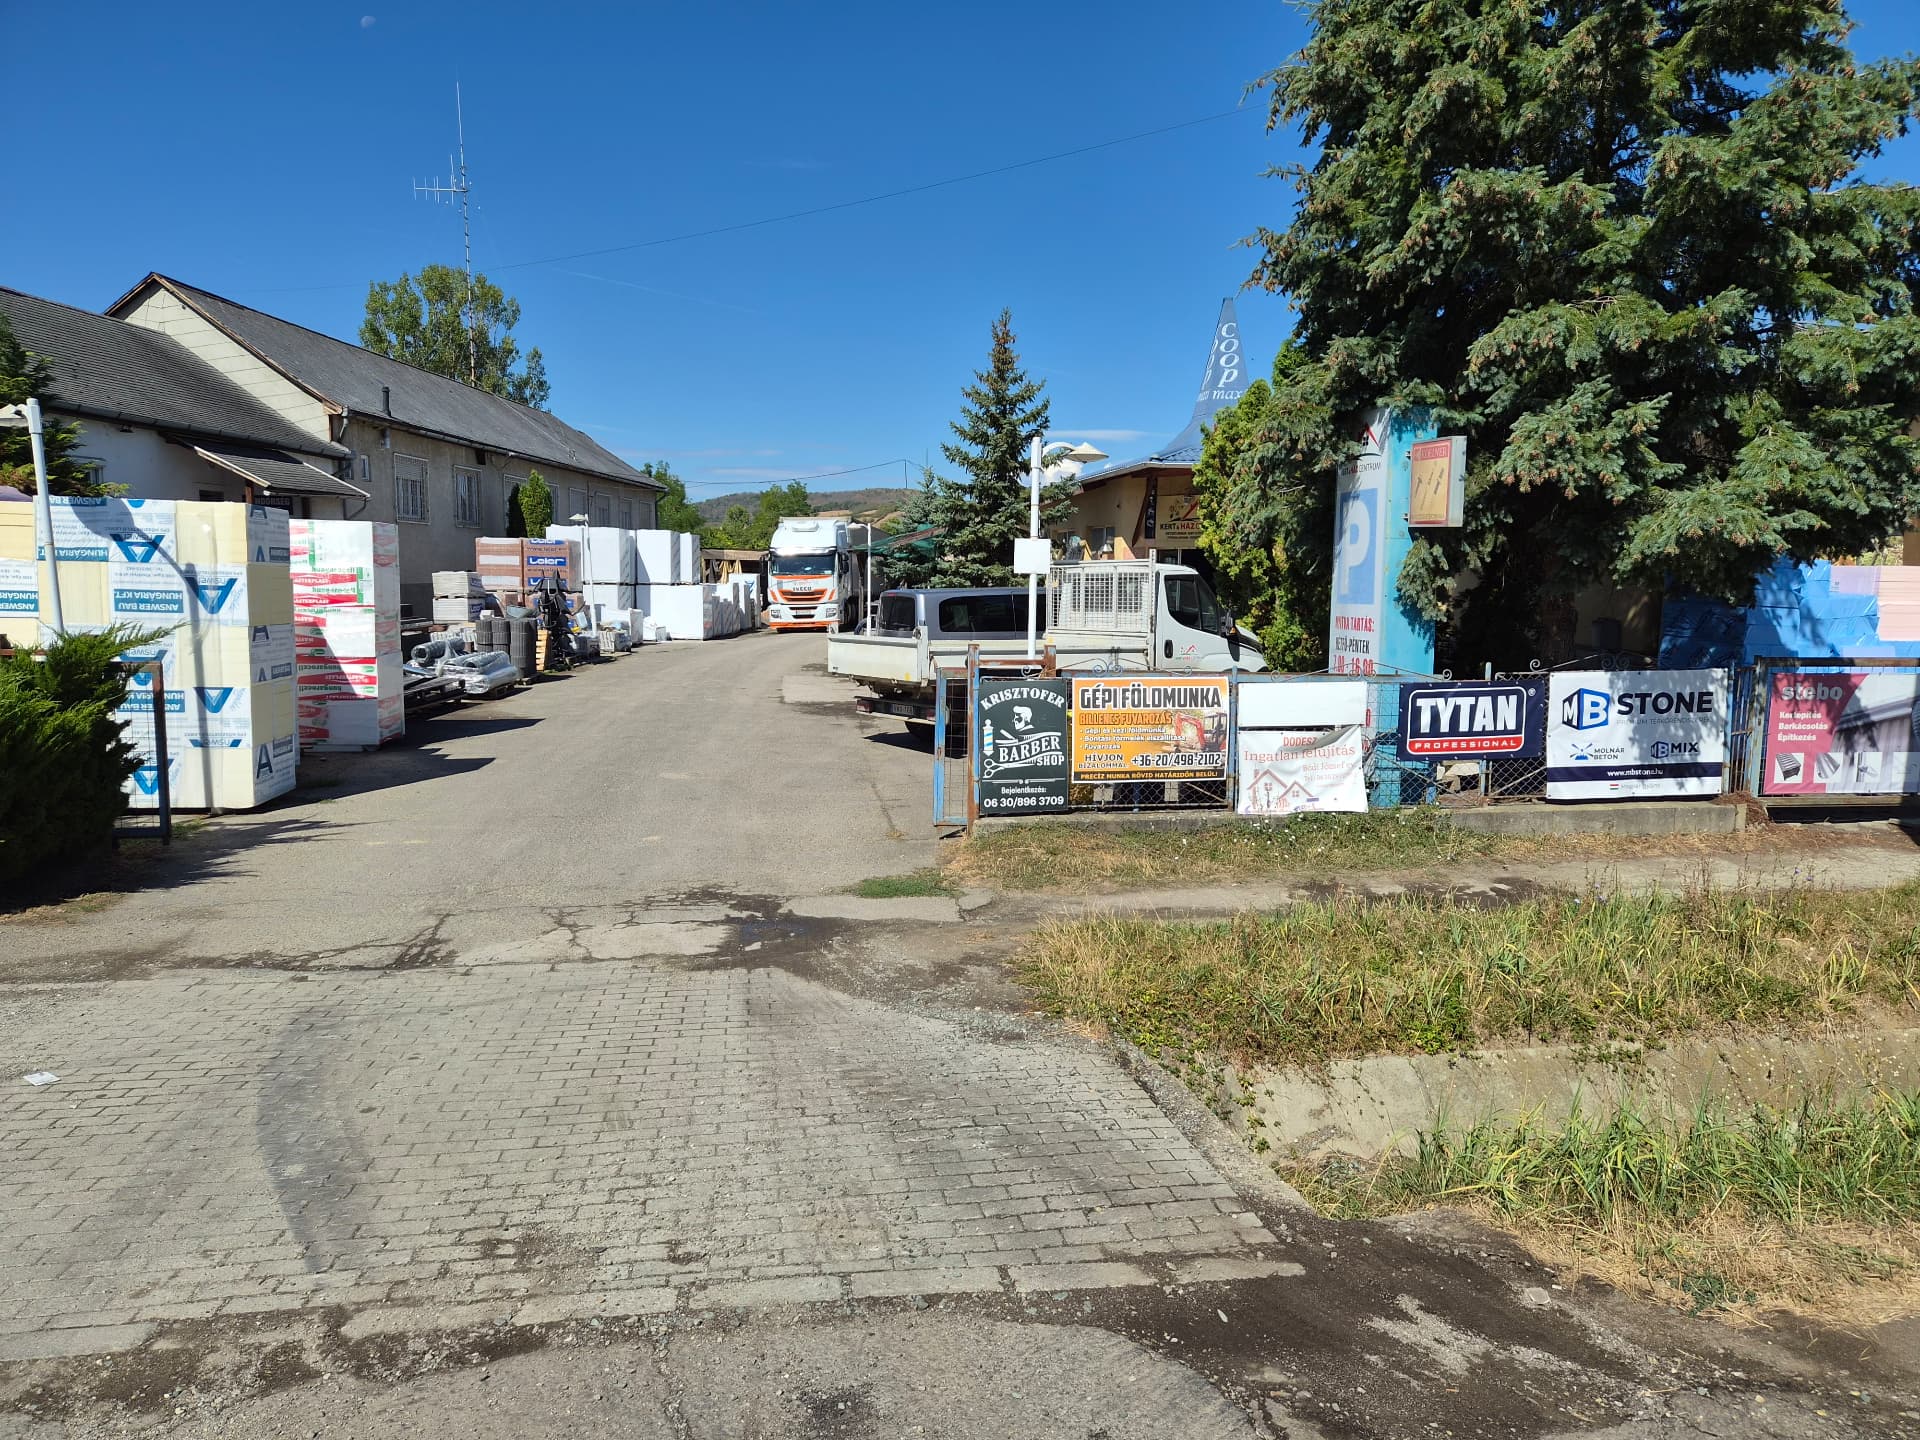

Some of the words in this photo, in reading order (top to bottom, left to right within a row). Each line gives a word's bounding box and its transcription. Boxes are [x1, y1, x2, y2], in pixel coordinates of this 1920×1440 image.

[134, 591, 183, 600] HUNGÁRIA
[119, 602, 137, 610] BAU
[138, 603, 179, 611] ANSWER
[1080, 683, 1118, 709] GÉPI
[1121, 683, 1222, 709] FÖLDMUNKA
[1781, 682, 1843, 700] stebo
[980, 687, 1065, 711] KRISZTOFER
[1617, 691, 1714, 715] STONE
[1416, 694, 1518, 733] TYTAN
[1778, 721, 1829, 730] Barkácsolás
[1777, 732, 1817, 742] Építkezés
[999, 735, 1061, 763] BARBER
[1414, 739, 1517, 749] PROFESSIONAL
[1671, 742, 1699, 753] MIX
[1036, 754, 1065, 766] SHOP
[1085, 753, 1124, 762] HÍVJON
[1132, 753, 1222, 767] +36-20/498-2102
[1244, 749, 1299, 763] Ingatlan
[983, 798, 998, 808] 06
[1000, 796, 1037, 809] 30/896
[1038, 796, 1065, 806] 3709
